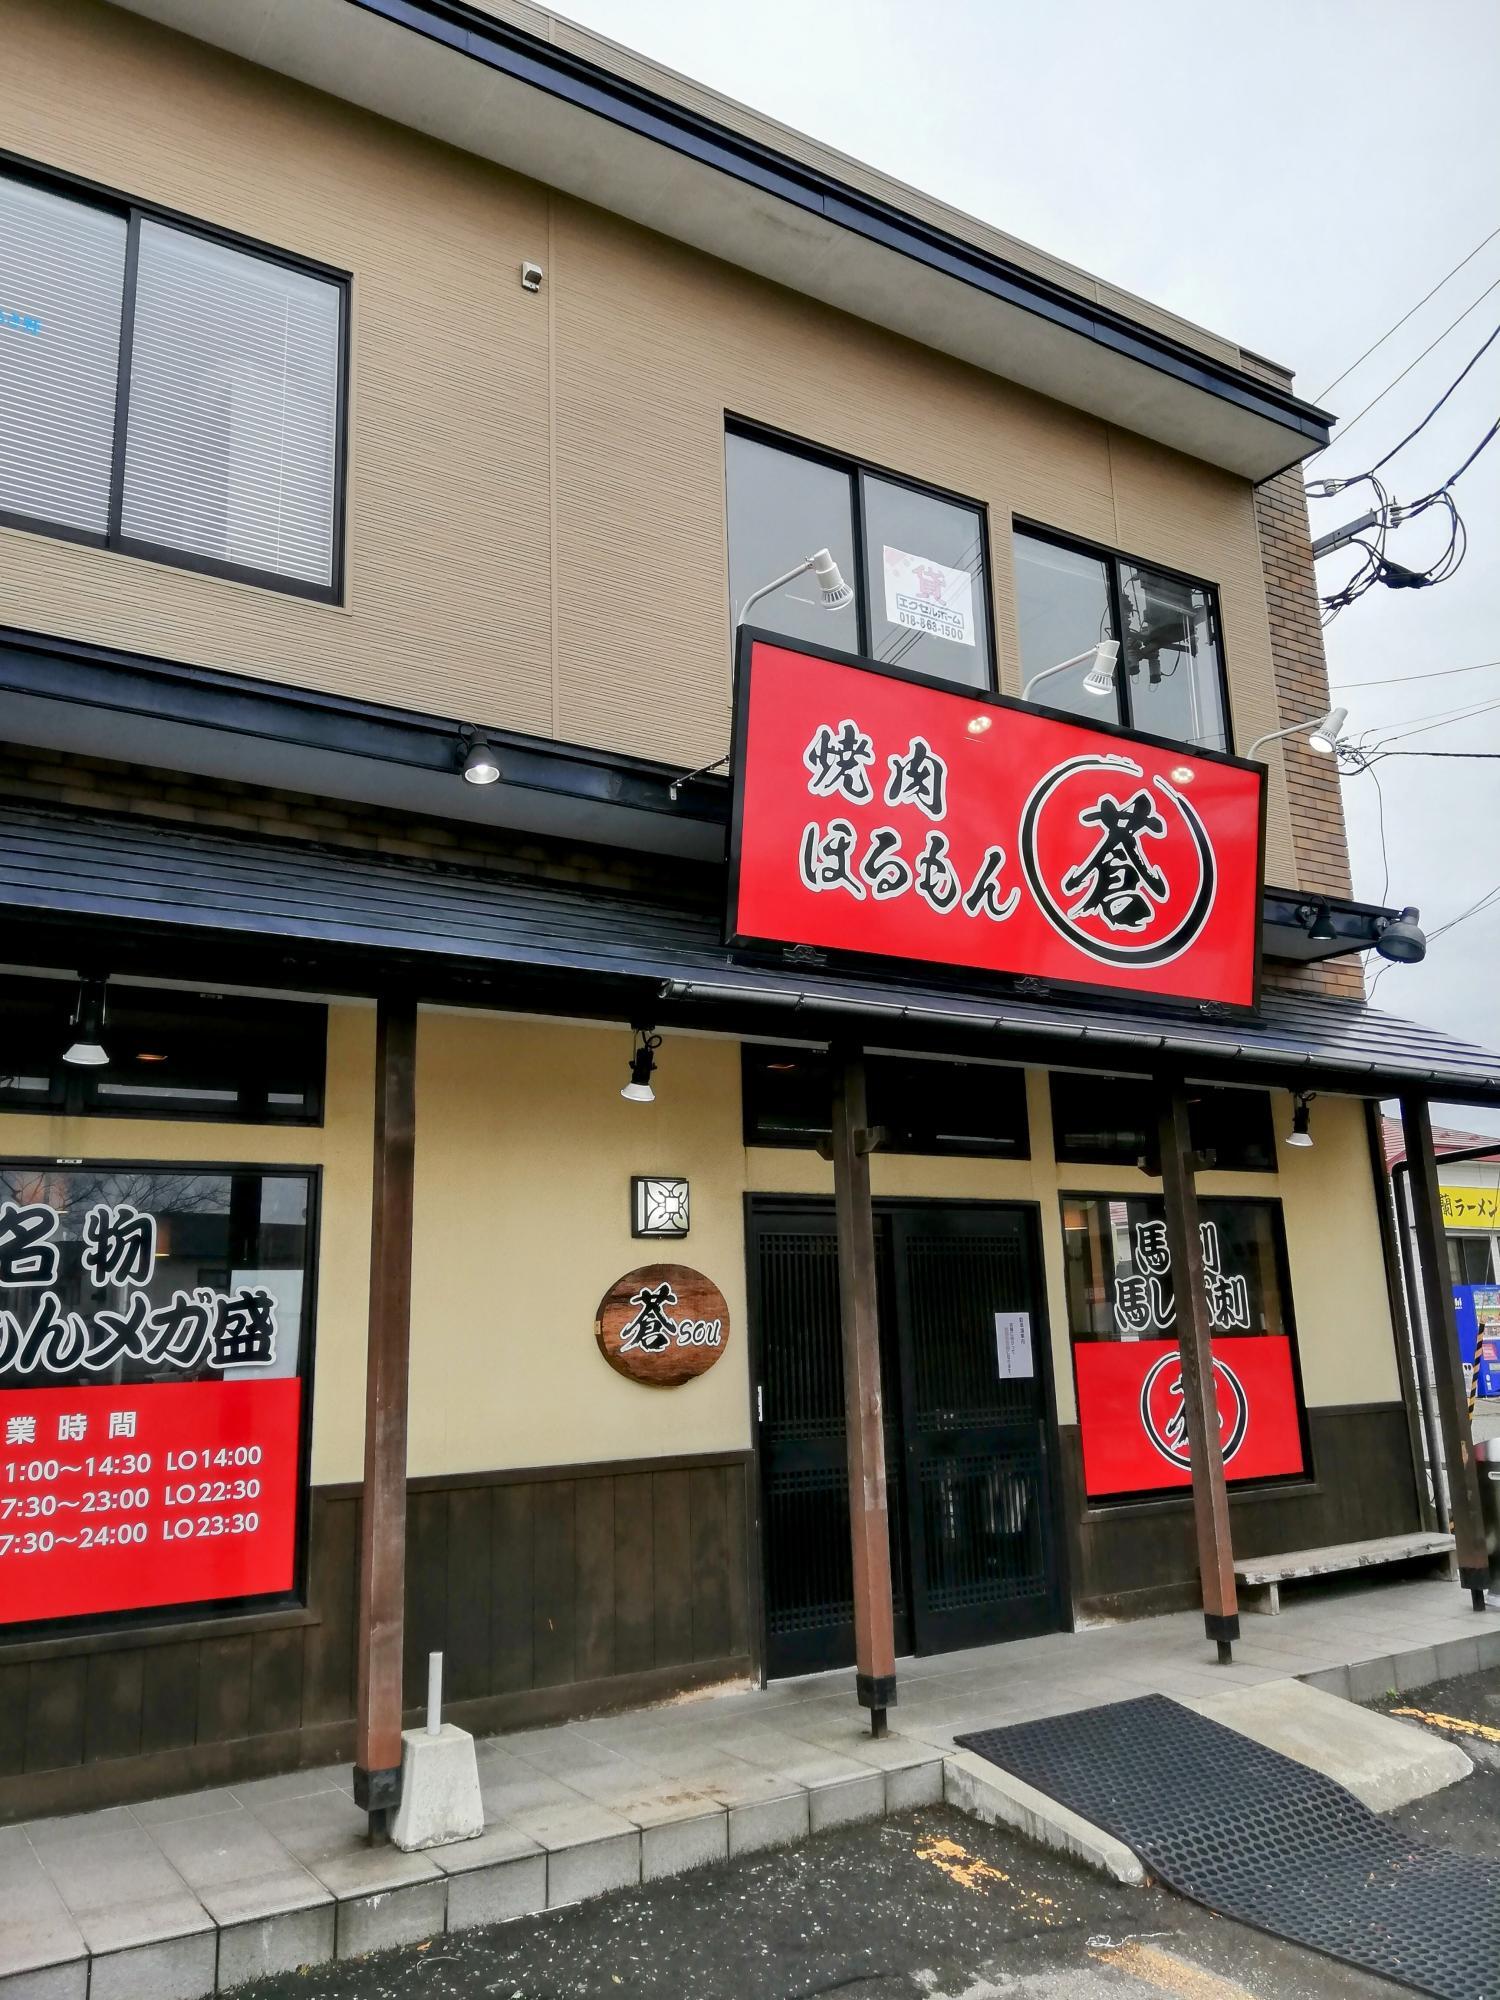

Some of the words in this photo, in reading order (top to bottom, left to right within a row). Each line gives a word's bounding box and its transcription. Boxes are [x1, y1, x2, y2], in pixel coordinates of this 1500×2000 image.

[899, 597, 961, 625] エクセルホーム
[900, 612, 964, 640] 018-863-1500
[803, 719, 947, 820] 焼肉
[799, 818, 1021, 921] ほるもん
[1061, 788, 1169, 932] 蒼
[0, 1202, 156, 1287] 名物
[620, 1282, 677, 1352] 蒼
